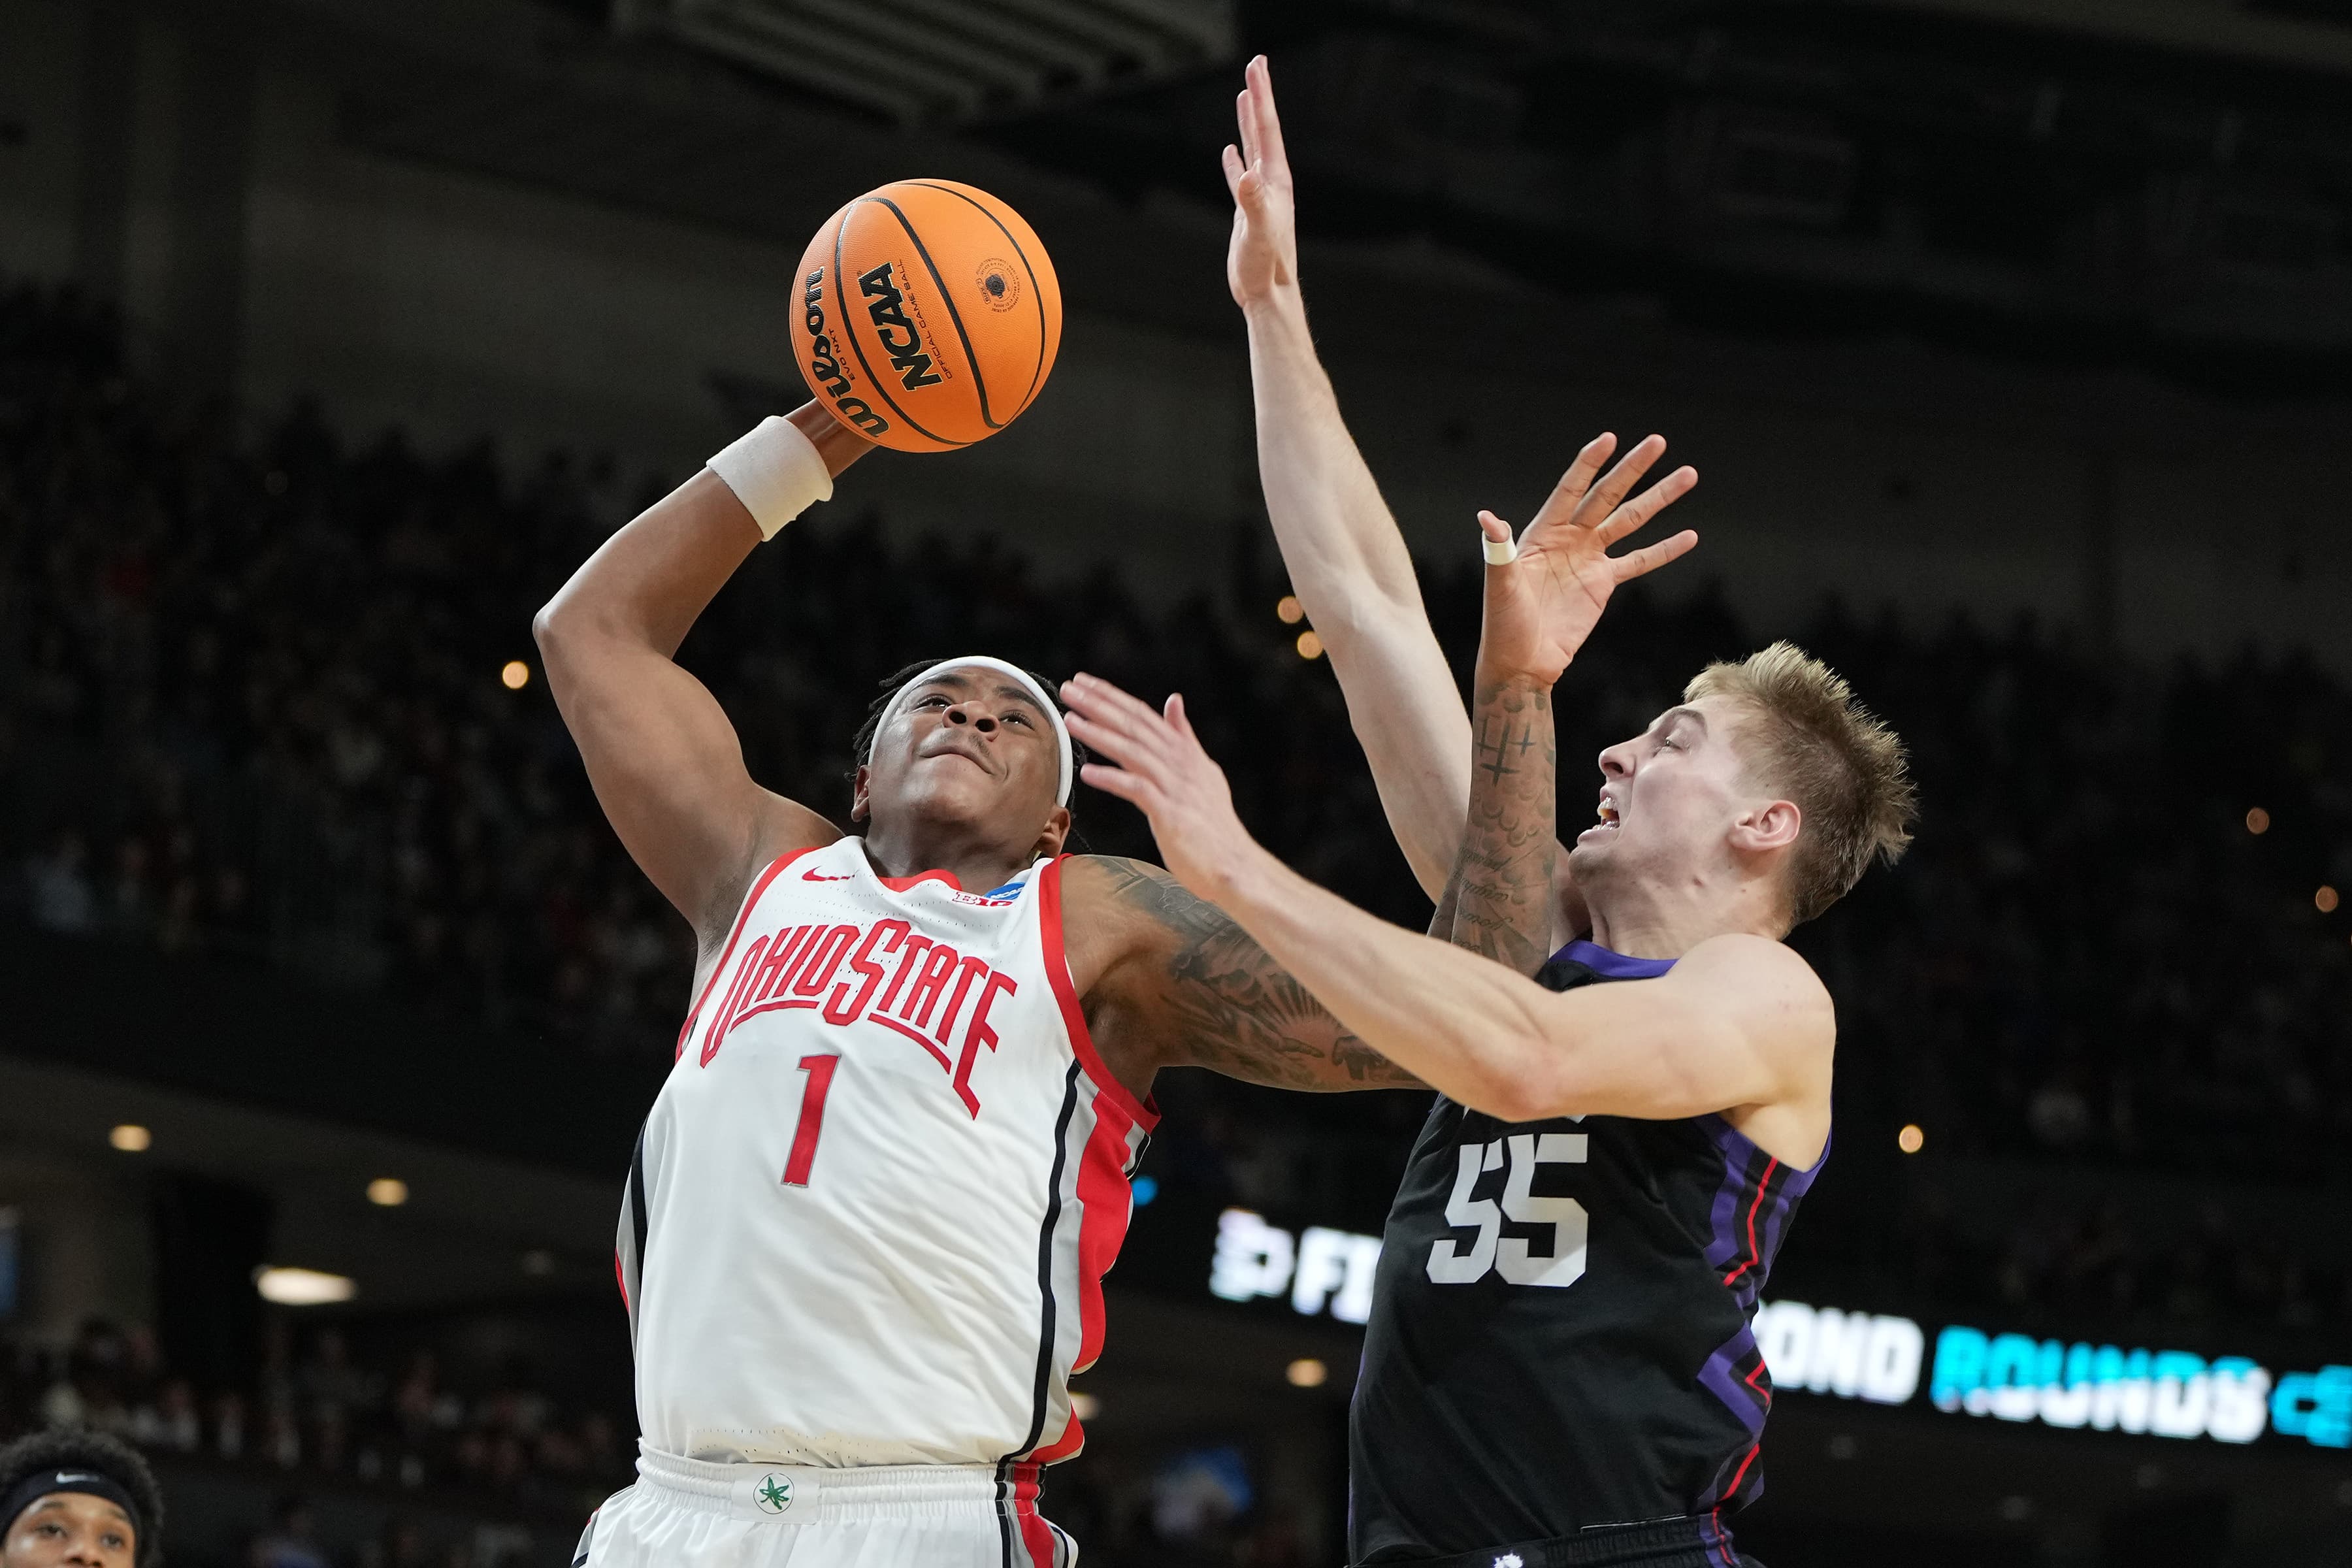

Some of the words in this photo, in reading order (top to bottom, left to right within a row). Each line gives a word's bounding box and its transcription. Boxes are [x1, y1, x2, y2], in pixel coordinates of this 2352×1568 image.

[897, 259, 911, 291] BALL
[907, 293, 926, 329] GAME
[828, 328, 841, 353] NXT
[839, 357, 856, 381] EVO
[857, 261, 943, 391] NCAA
[926, 331, 953, 379] OFFICIAL
[700, 924, 860, 1068] OHIO
[823, 919, 1017, 1120] STATE
[781, 1053, 841, 1188] 1
[1426, 1134, 1588, 1287] 55
[1751, 1299, 1925, 1405] OND
[1931, 1324, 2271, 1445] ROUNDS
